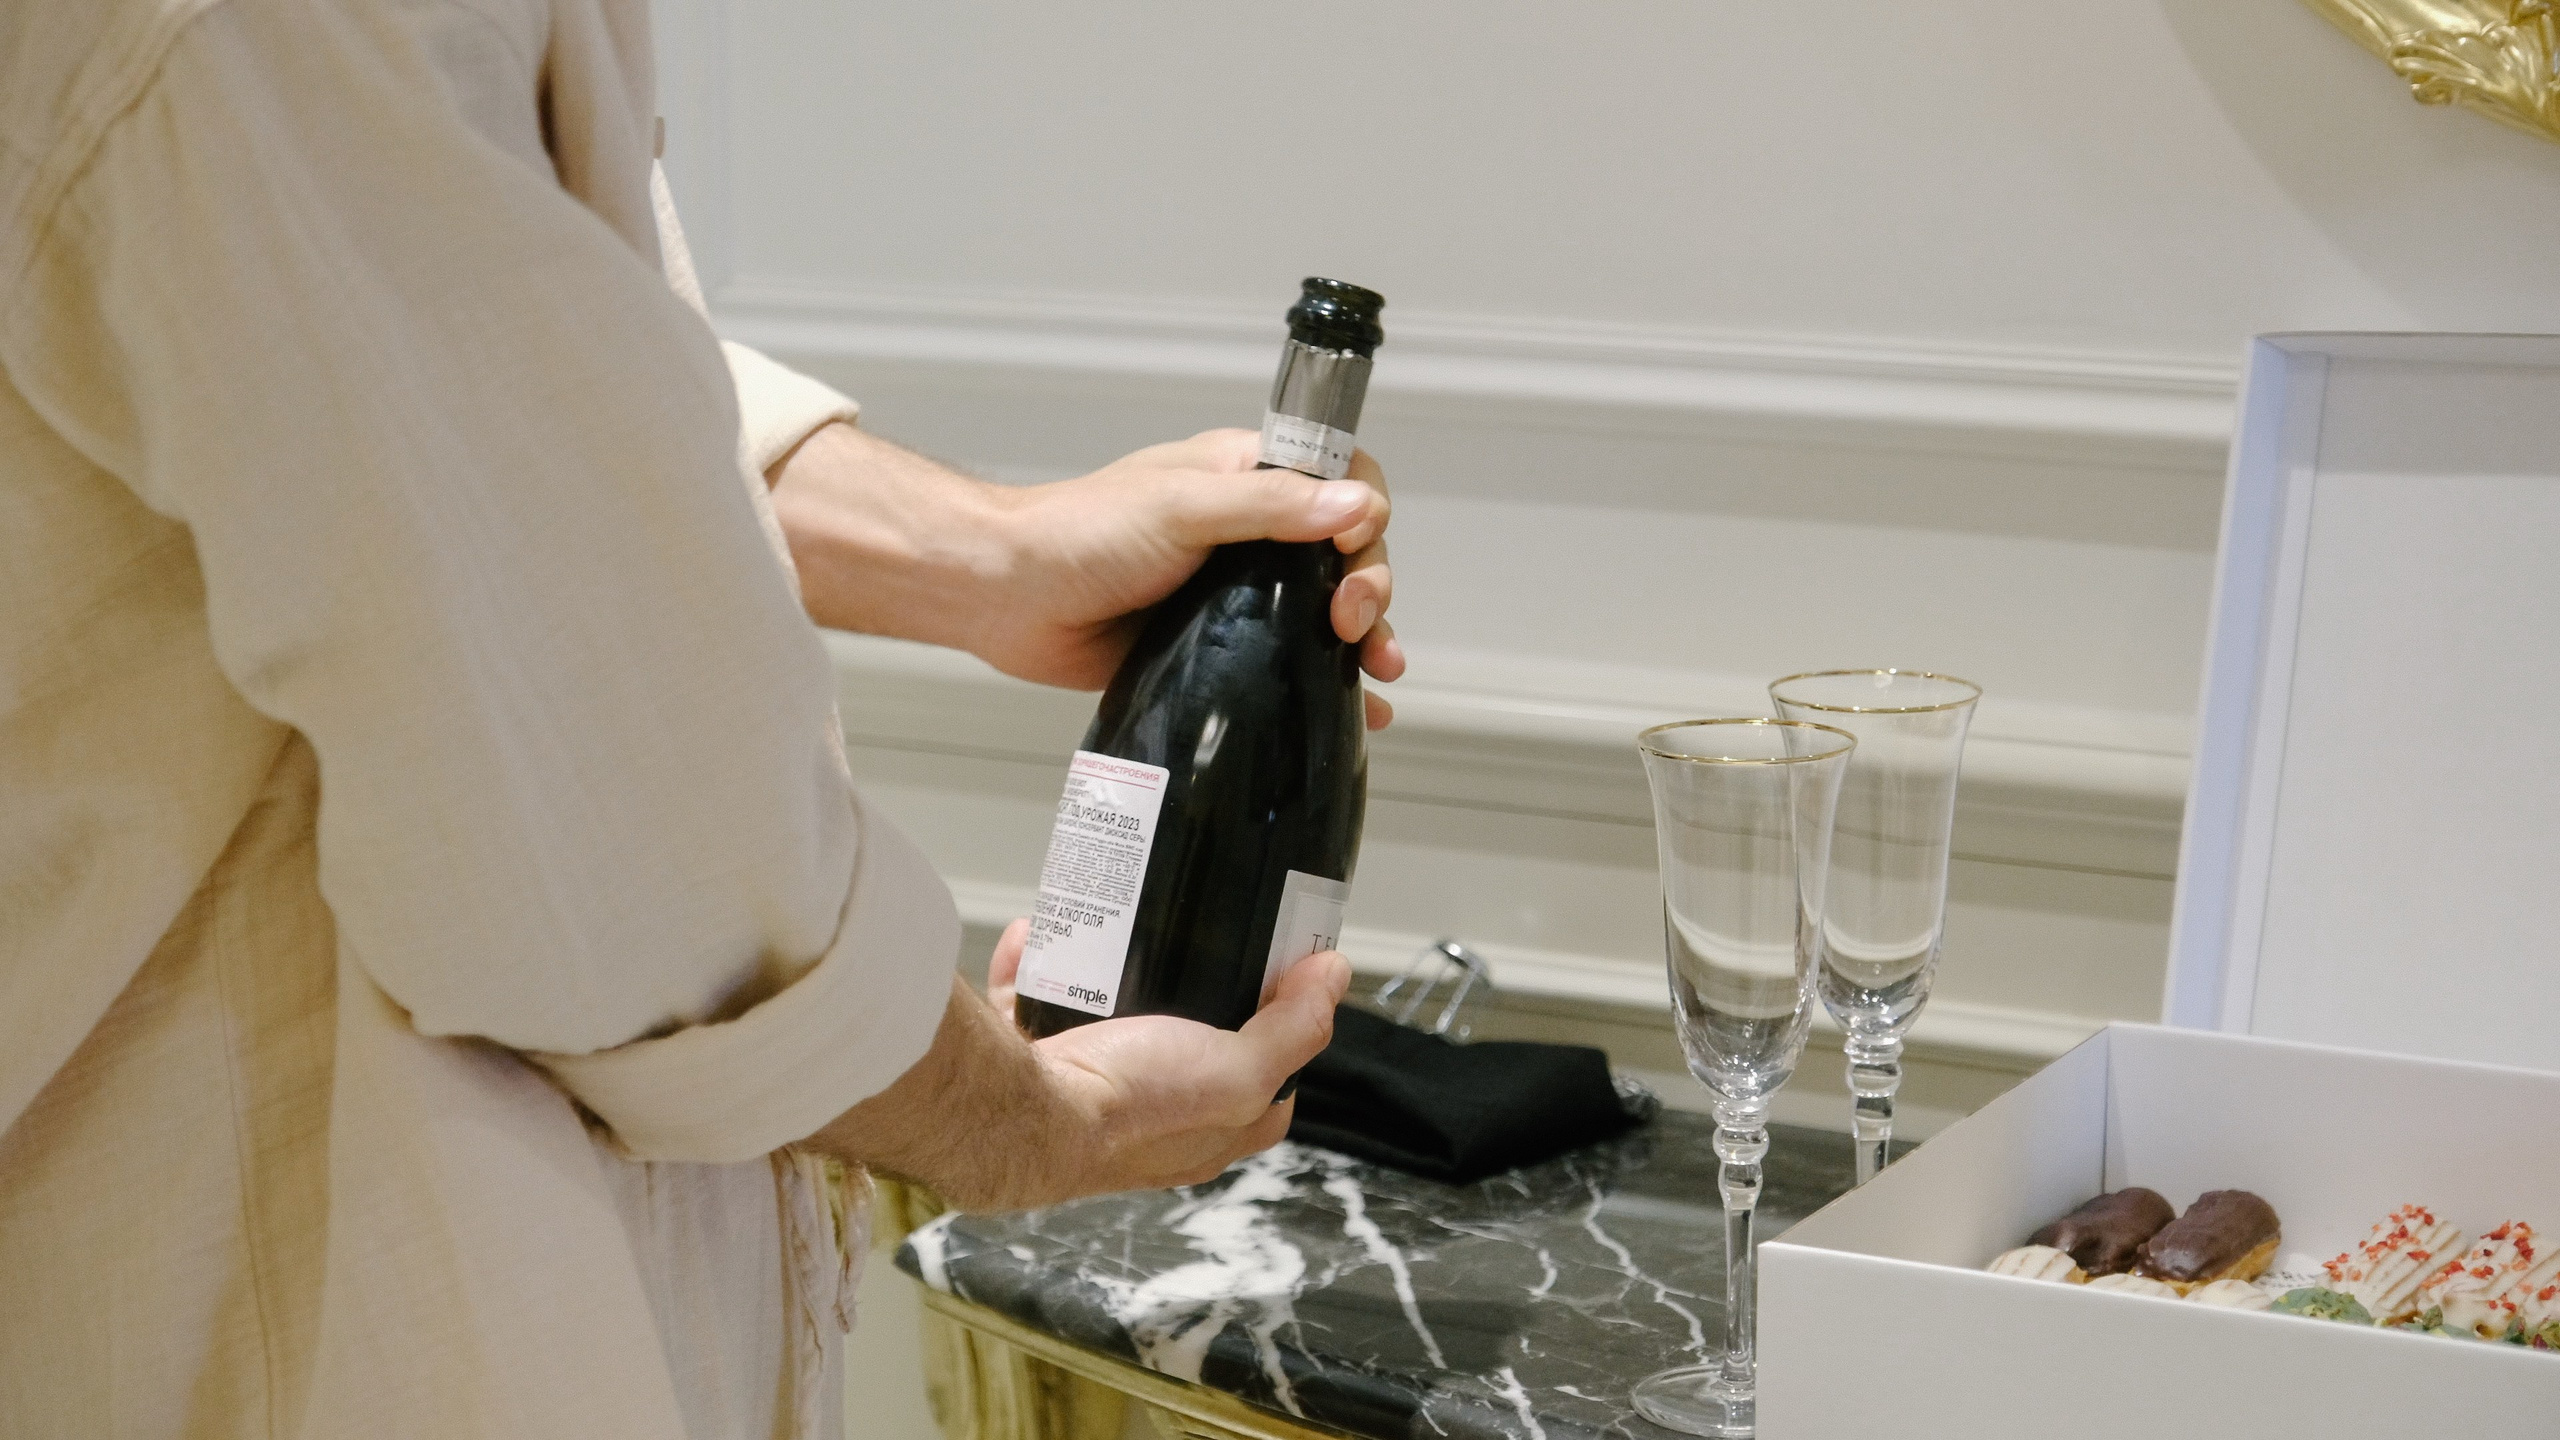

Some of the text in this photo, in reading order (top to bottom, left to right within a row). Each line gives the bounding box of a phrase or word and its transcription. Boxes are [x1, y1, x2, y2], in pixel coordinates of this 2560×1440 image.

[1080, 806, 1116, 825] УРОЖАЯ
[1117, 814, 1140, 831] 2023
[1056, 906, 1104, 928] АЛКОГОЛЯ
[1067, 984, 1107, 1005] simple
